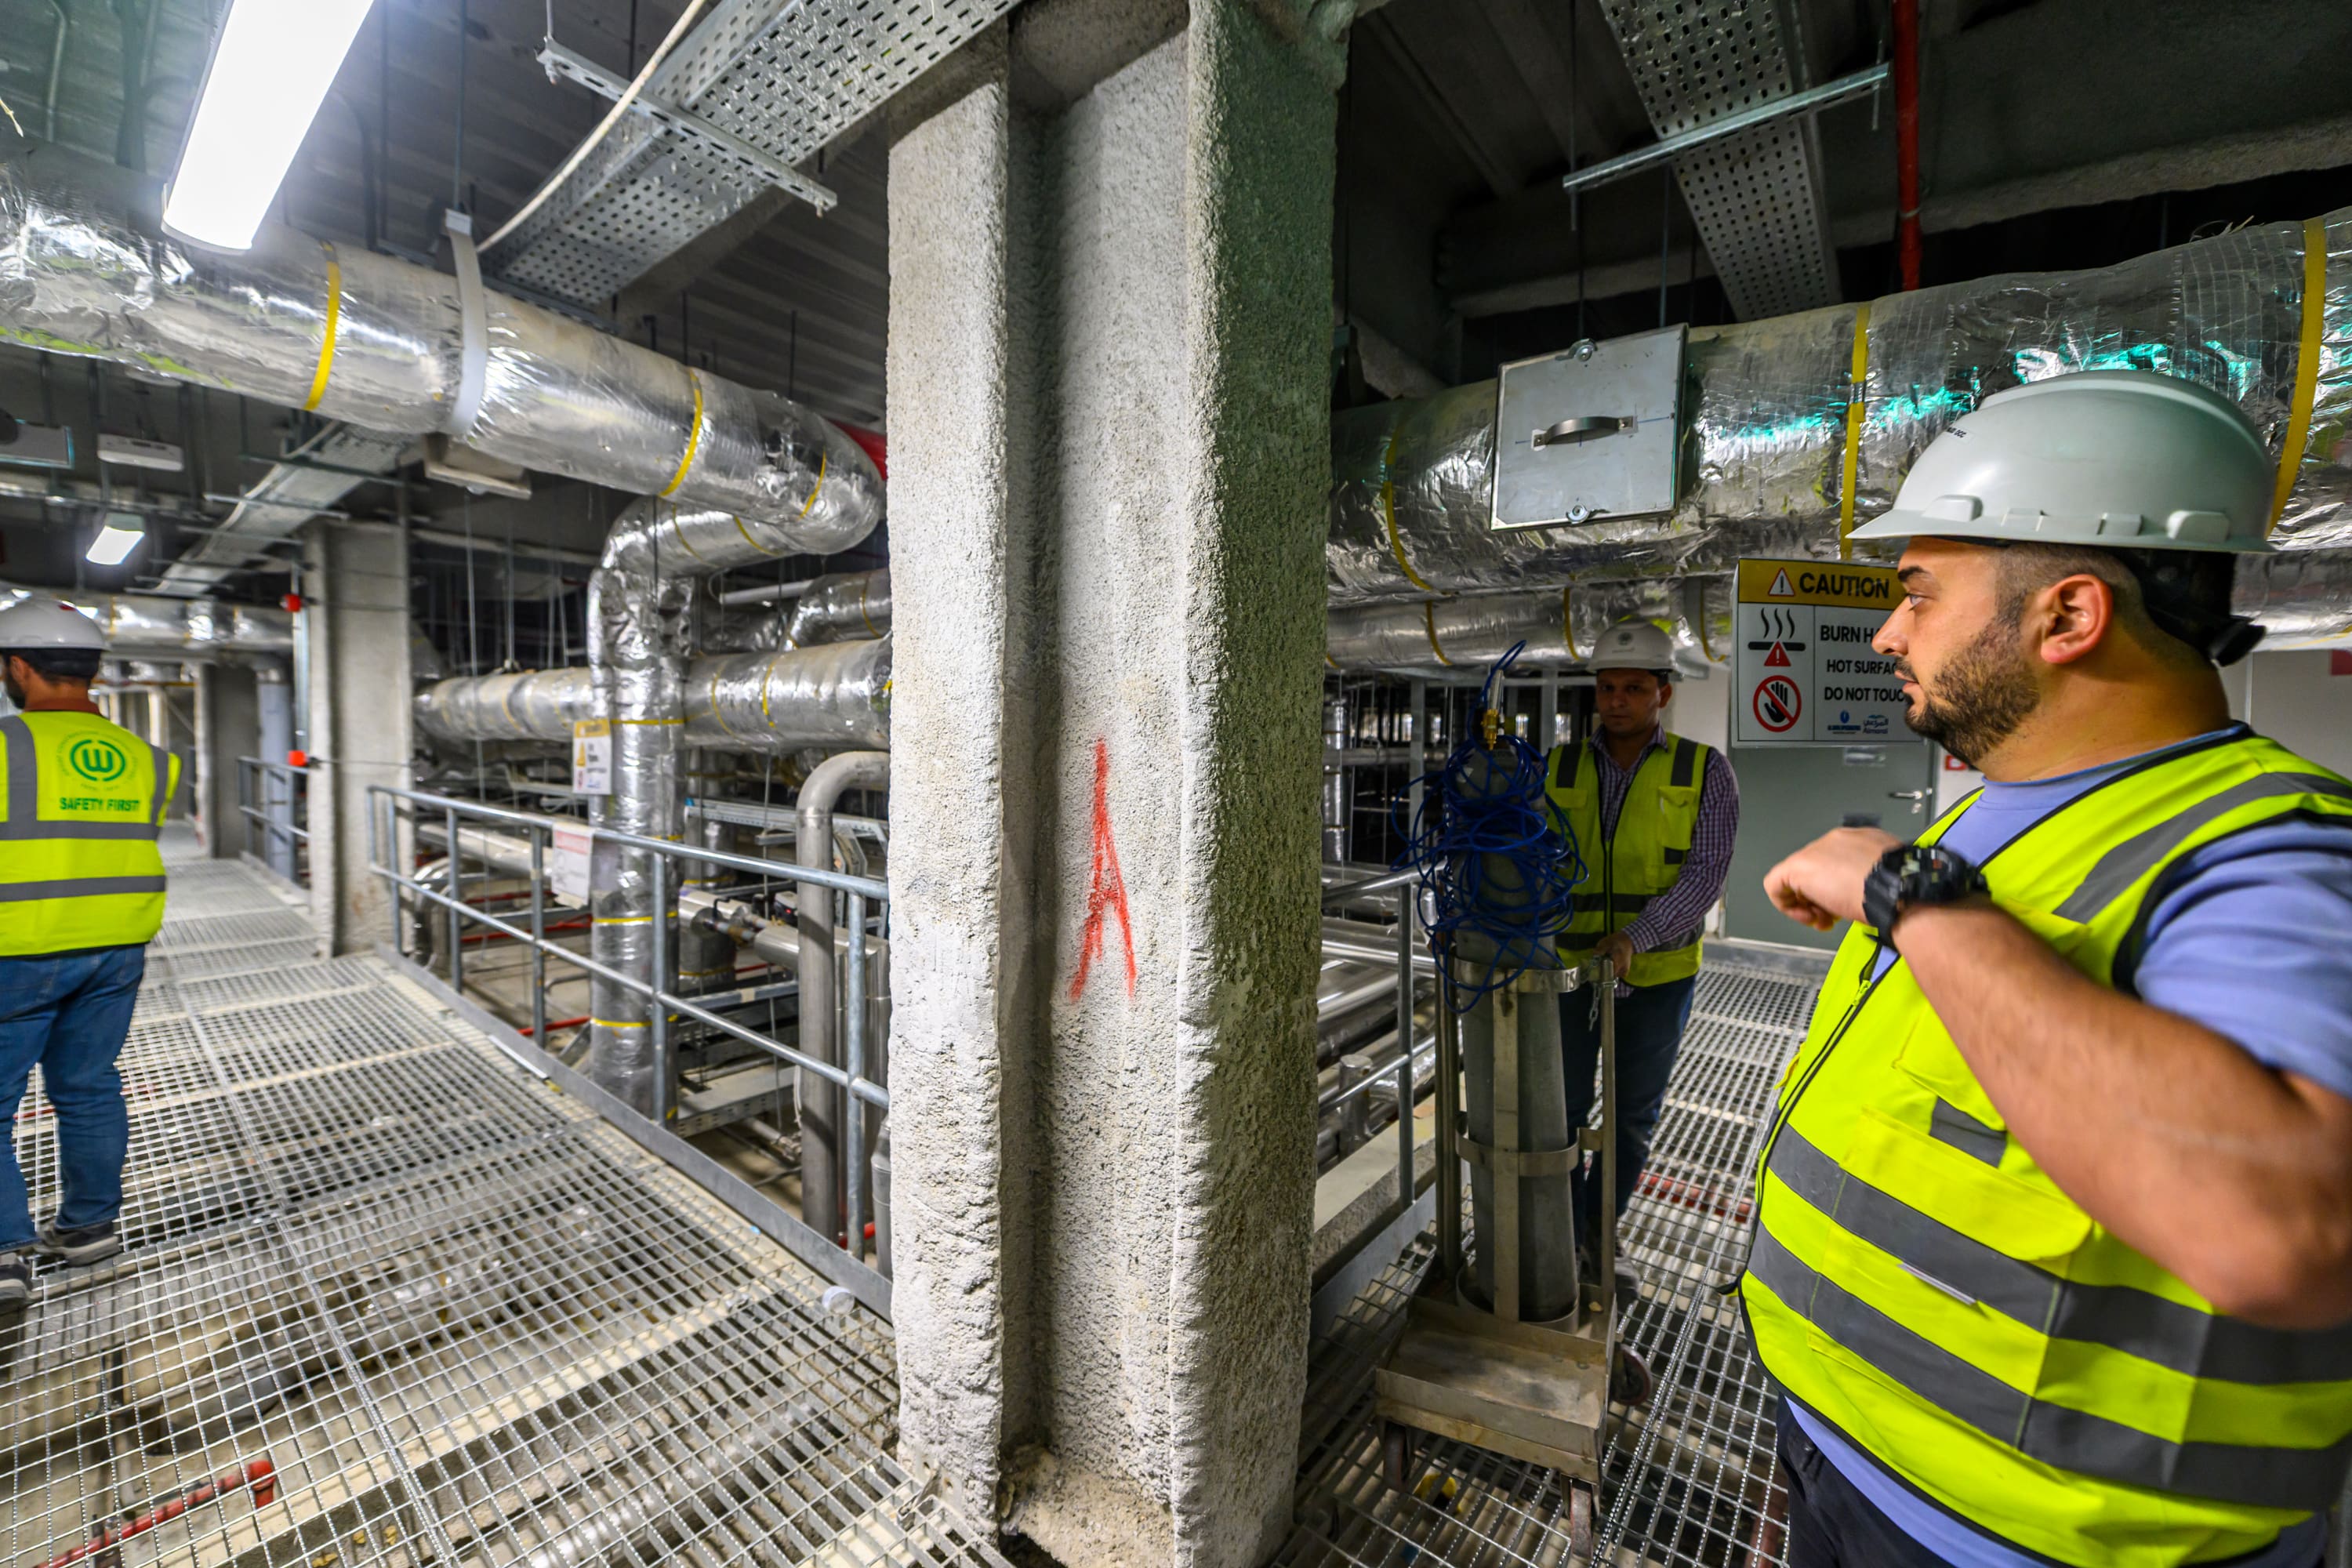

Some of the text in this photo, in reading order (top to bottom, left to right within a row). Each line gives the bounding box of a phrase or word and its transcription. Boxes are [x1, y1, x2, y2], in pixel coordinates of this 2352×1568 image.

[1799, 572, 1889, 598] CAUTION
[1820, 625, 1860, 643] BURN
[1827, 659, 1853, 673] HOT
[1824, 687, 1907, 702] DO NOT TOUC
[60, 797, 140, 811] SAFETY FIRST
